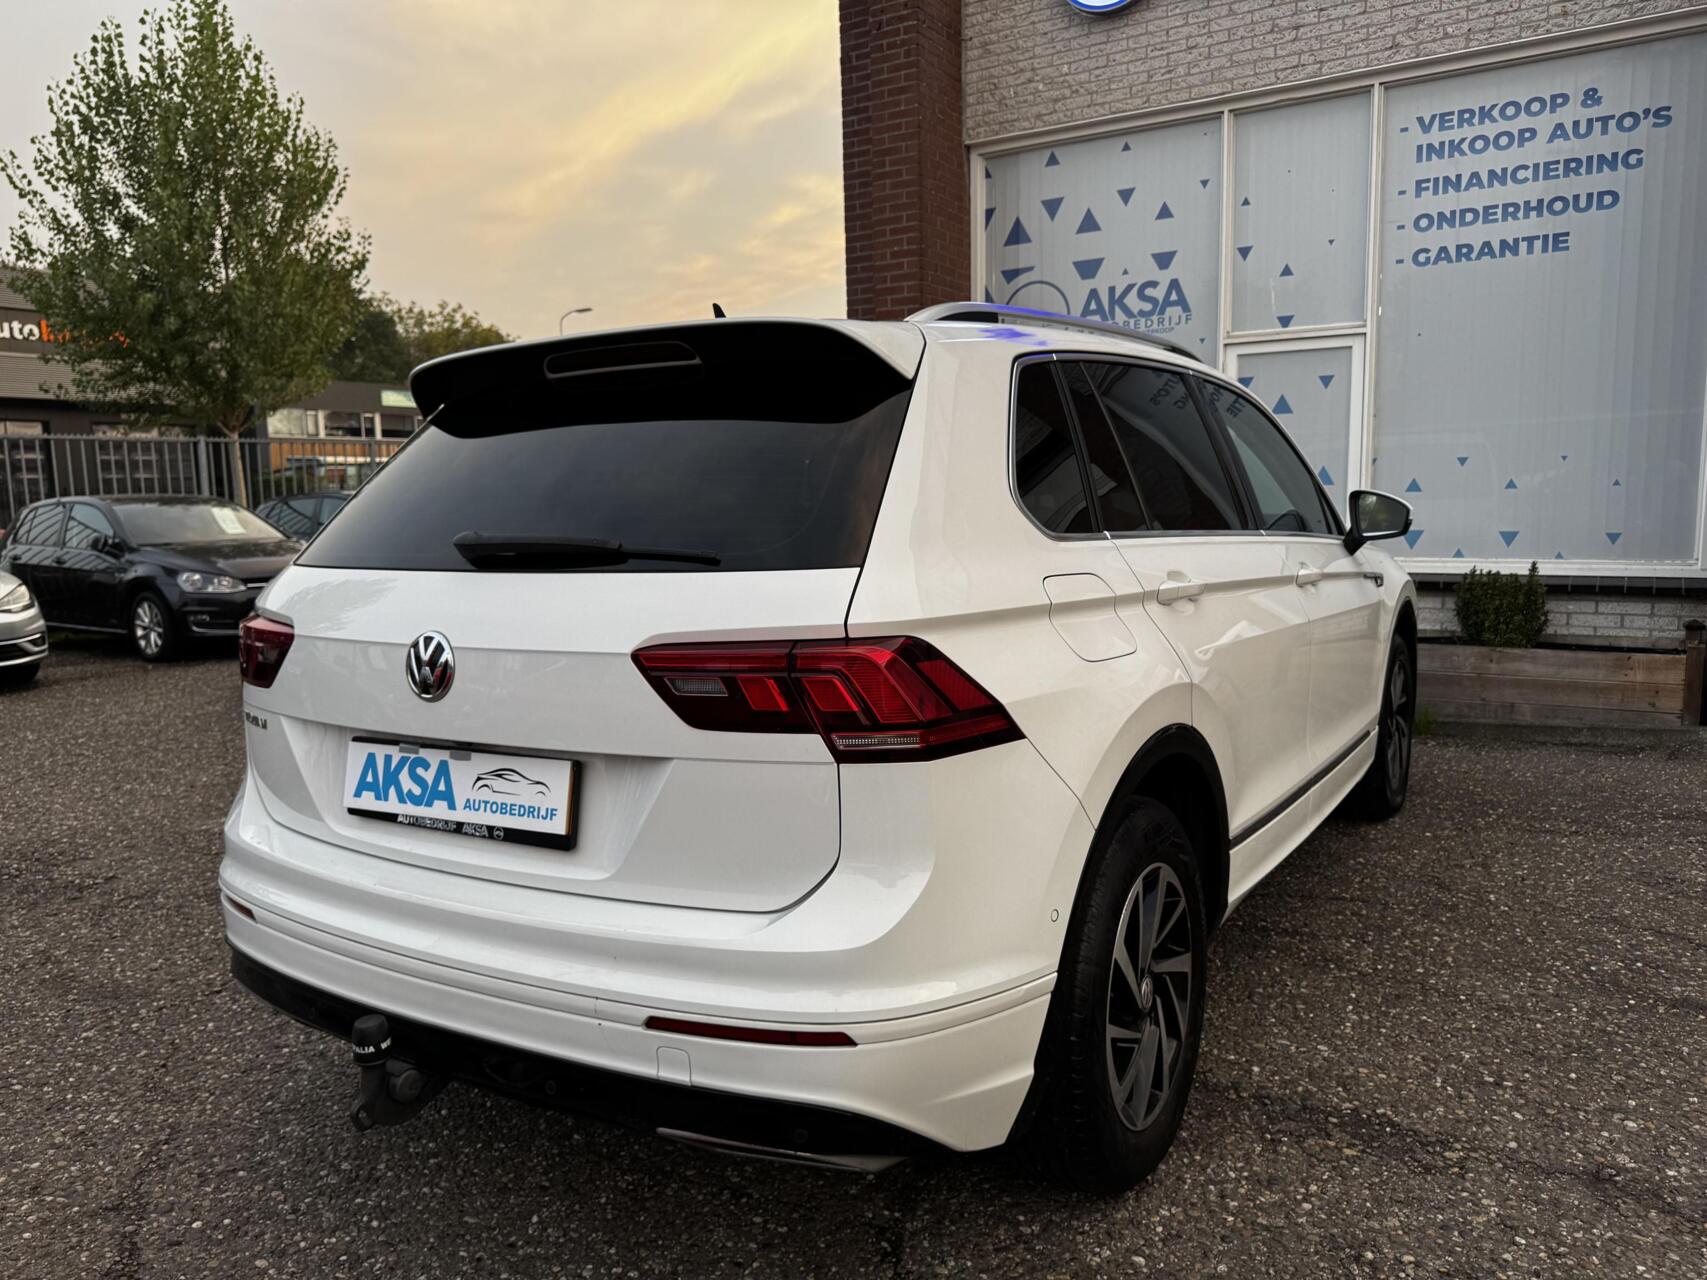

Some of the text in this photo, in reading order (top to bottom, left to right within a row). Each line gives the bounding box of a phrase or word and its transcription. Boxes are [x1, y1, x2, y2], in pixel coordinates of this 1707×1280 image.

[1415, 92, 1570, 134] VERKOOP
[1580, 87, 1603, 108] &
[1415, 105, 1673, 163] INKOOP AUTO'S
[1414, 148, 1644, 198] FINANCIERING
[1412, 190, 1620, 233] ONDERHOUD
[1411, 231, 1570, 267] GARANTIE
[1080, 278, 1192, 322] AKSA
[1112, 313, 1192, 330] BEDRIJF
[352, 752, 457, 811] AKSA
[462, 822, 489, 837] AKSA
[463, 798, 558, 821] AUTOBEDRIJF
